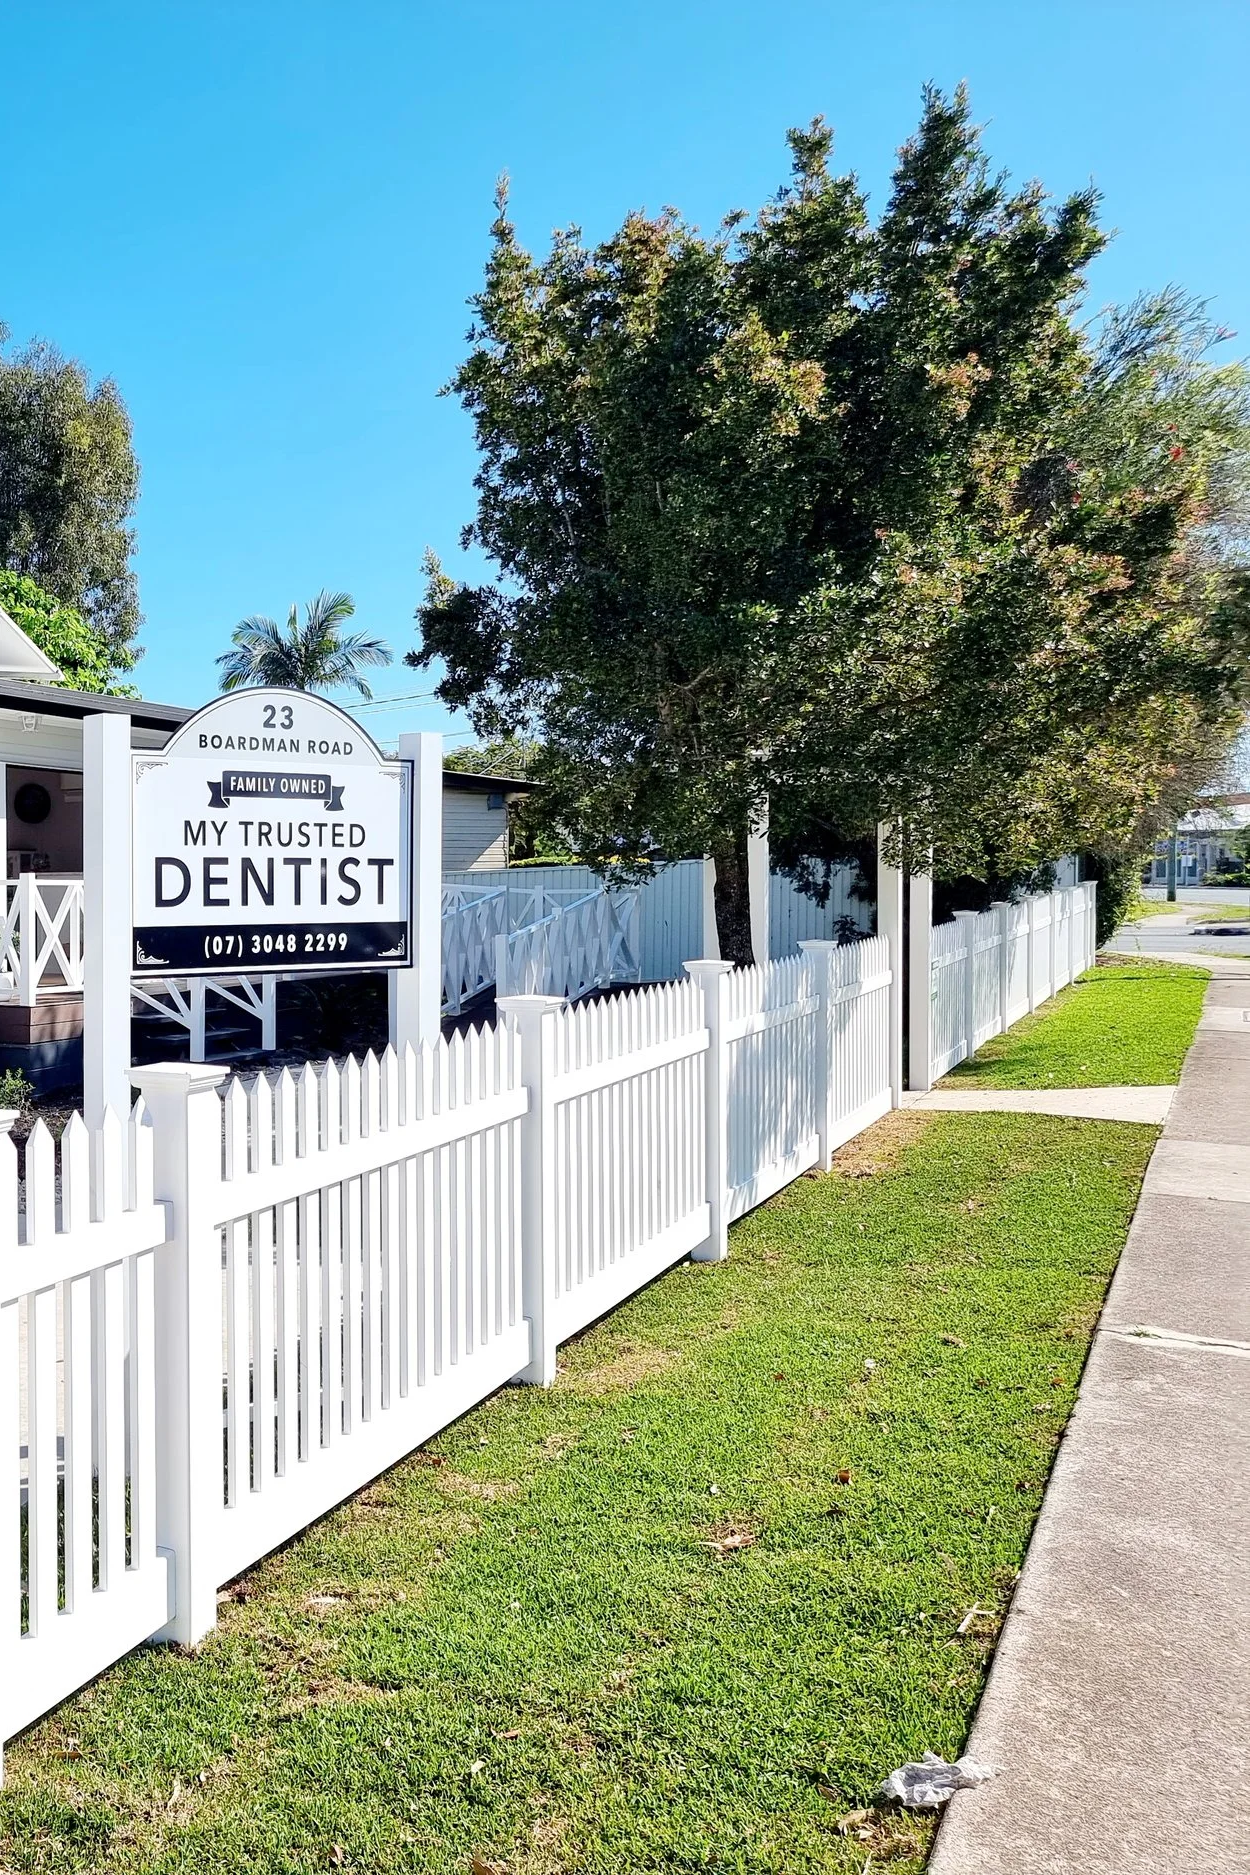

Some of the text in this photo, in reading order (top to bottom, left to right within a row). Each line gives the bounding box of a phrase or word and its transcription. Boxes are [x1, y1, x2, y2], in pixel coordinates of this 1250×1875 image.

[262, 704, 294, 730] 23
[198, 733, 353, 756] BOARDMAN ROAD
[230, 776, 326, 794] FAMILY OWNED
[184, 819, 366, 848] MY TRUSTED
[154, 856, 395, 908] DENTIST
[204, 932, 348, 959] (07) 3048 2299
